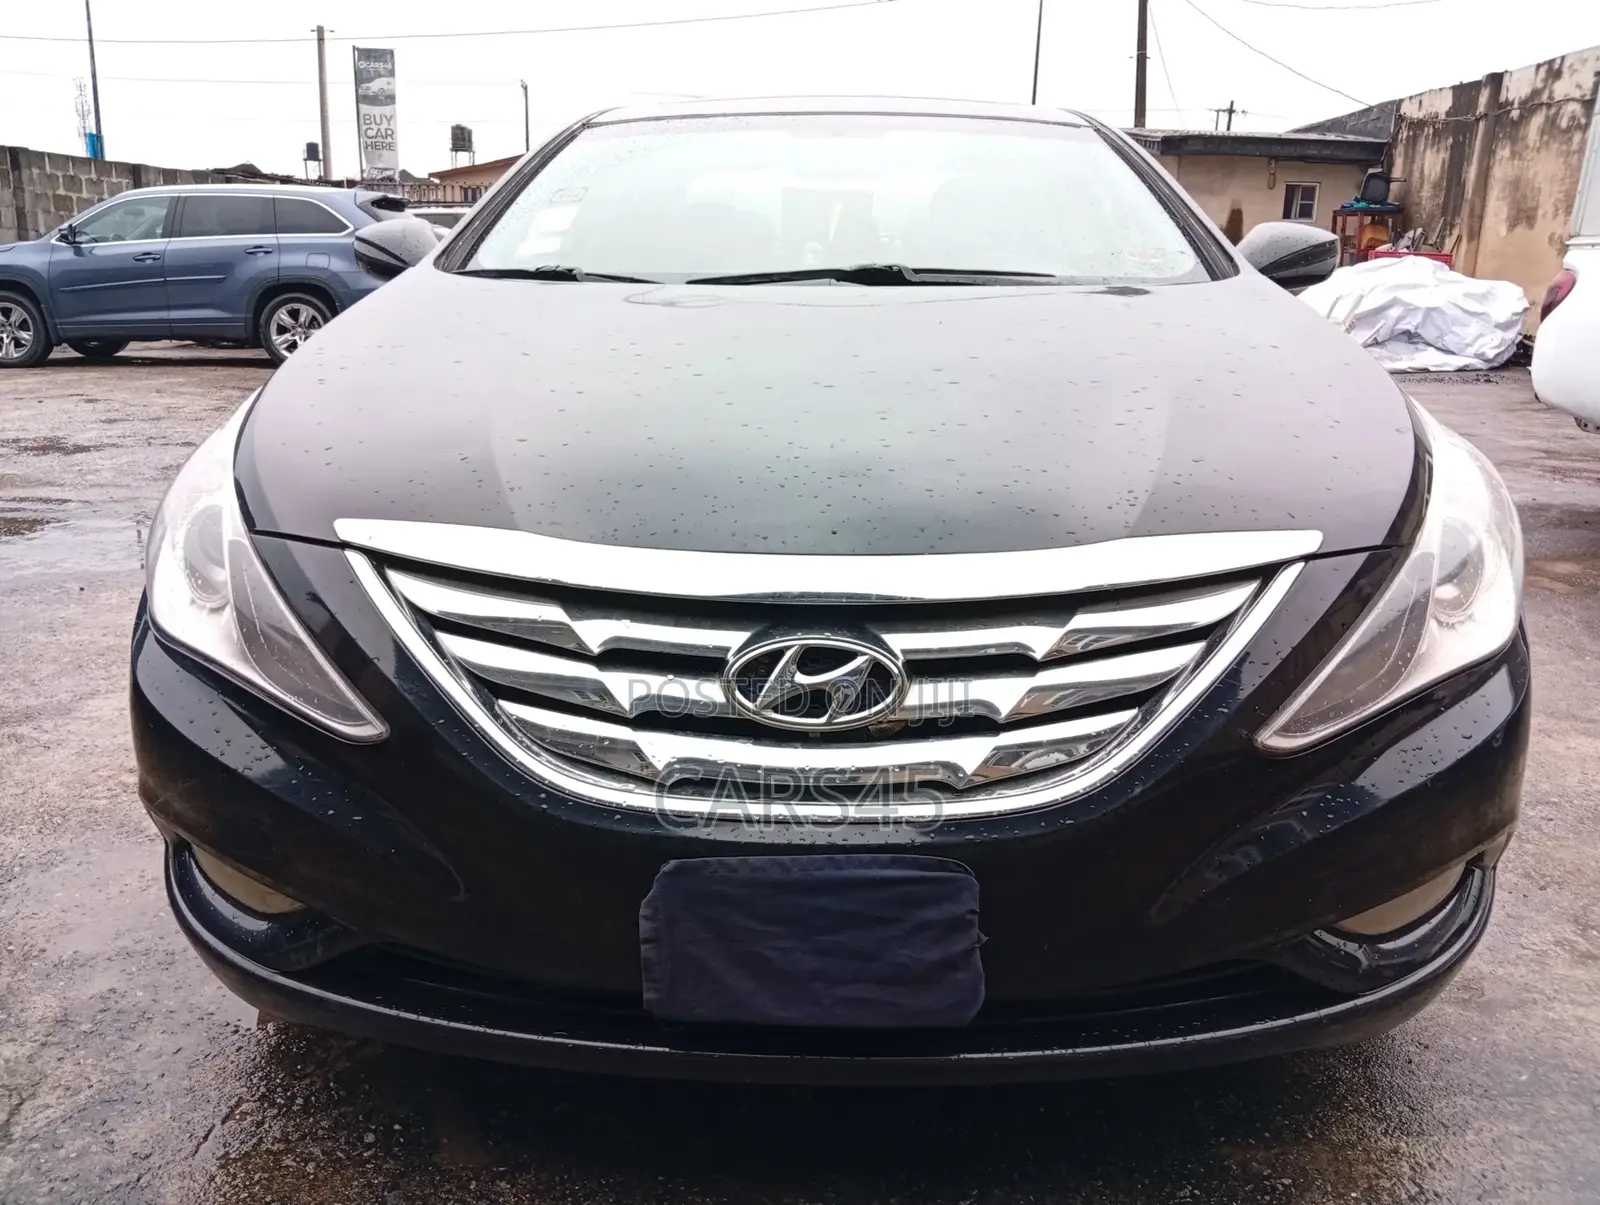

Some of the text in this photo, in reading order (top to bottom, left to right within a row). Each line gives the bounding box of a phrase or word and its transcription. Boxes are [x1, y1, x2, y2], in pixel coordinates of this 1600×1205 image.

[362, 113, 394, 127] BUY
[363, 127, 396, 141] CAR
[364, 140, 396, 152] HERE
